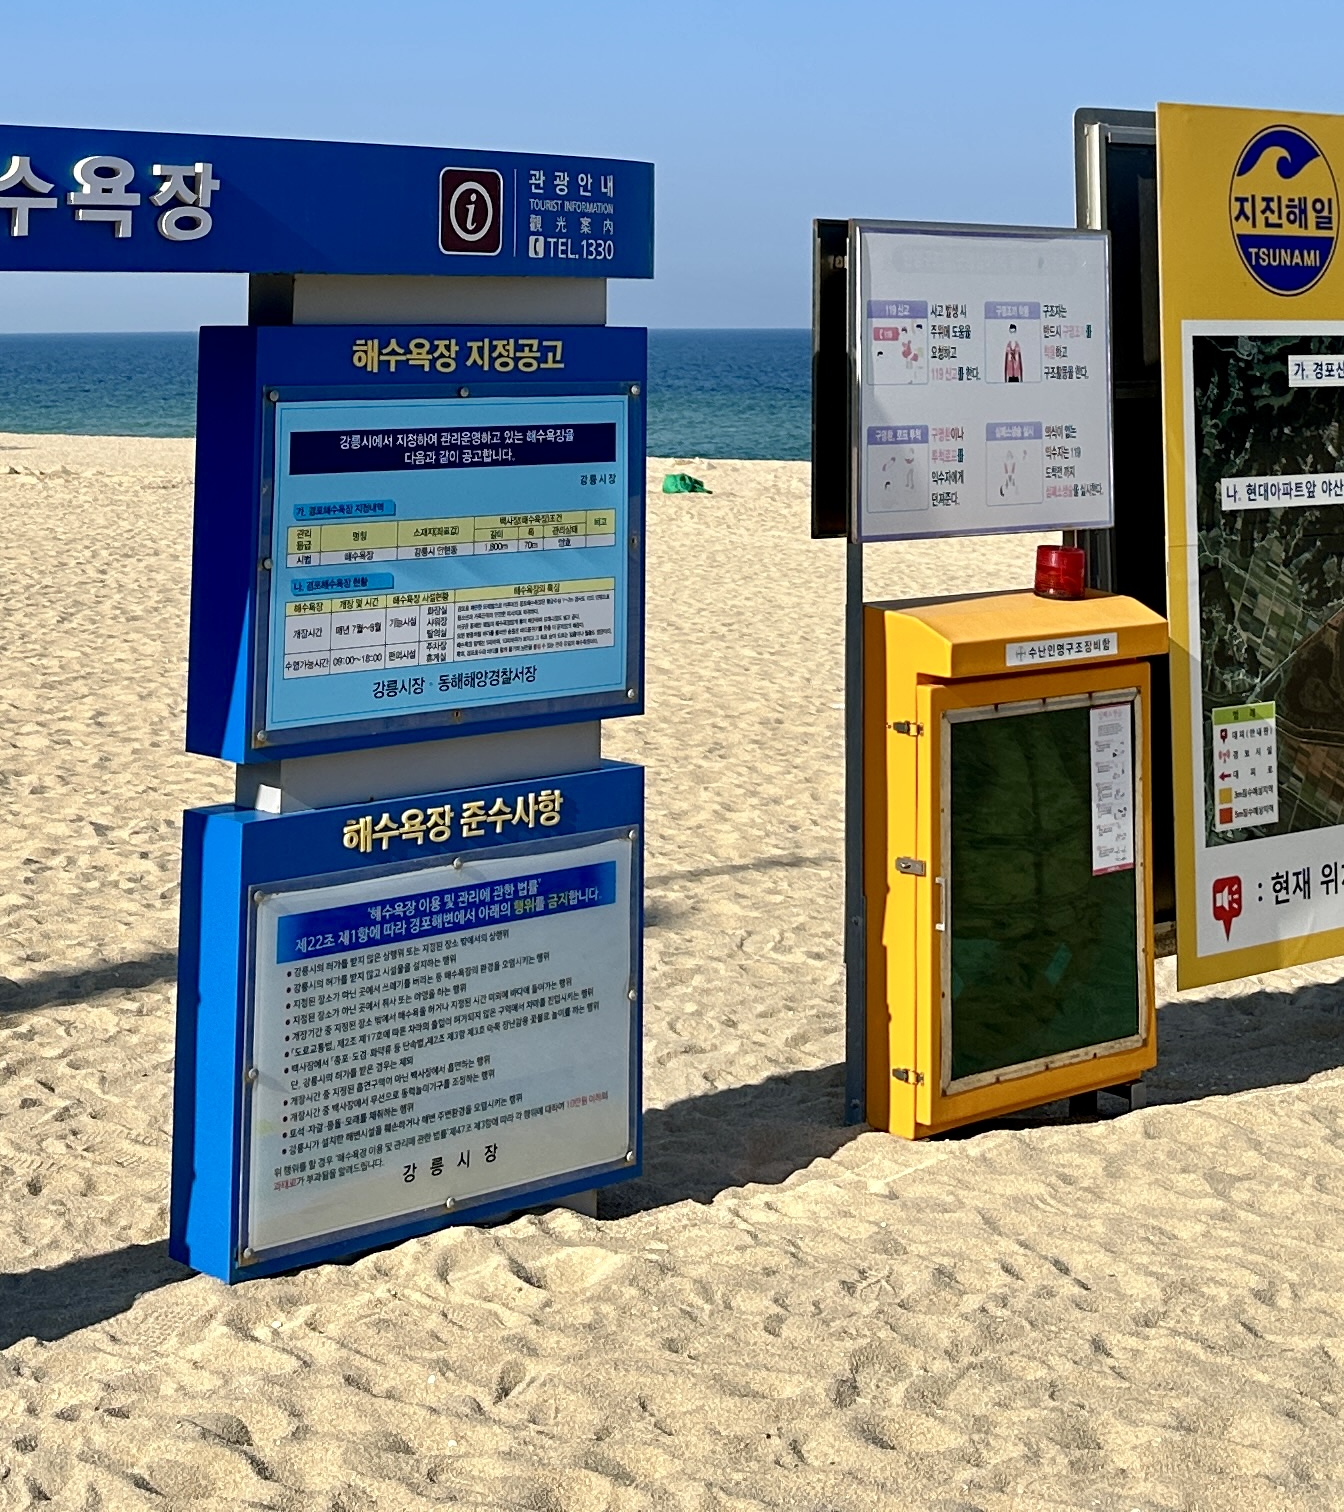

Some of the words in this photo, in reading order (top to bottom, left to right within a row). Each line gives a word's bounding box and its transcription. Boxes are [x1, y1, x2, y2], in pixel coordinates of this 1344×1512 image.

[529, 199, 562, 211] TOURIST
[564, 200, 614, 214] INFORMATION
[1234, 194, 1333, 231] 지진해일
[1248, 247, 1320, 267] TSUNAMI
[352, 338, 458, 373] 해수욕장
[466, 338, 565, 372] 지정공고
[340, 433, 394, 450] 강릉시에서
[396, 432, 438, 448] 지정하여
[504, 430, 523, 444] 있는
[526, 428, 575, 443] 해수욕장을
[404, 450, 436, 465] 다음과
[439, 450, 459, 464] 같이
[579, 472, 617, 487] 강릉시장
[1246, 481, 1317, 502] 현대아파트앞
[1321, 479, 1344, 499] 야산
[1028, 637, 1111, 660] 수난인명구조장비함
[372, 677, 426, 700] 강릉시장
[437, 665, 538, 692] 동해해양경찰서장
[342, 804, 453, 853] 해수욕장
[460, 789, 564, 837] 준수사항
[457, 886, 490, 906] 관리에
[493, 882, 515, 900] 관한
[1271, 868, 1311, 906] 현재
[295, 933, 335, 953] 제22조
[409, 907, 476, 933] 경포해변에서
[479, 901, 511, 921] 아래의
